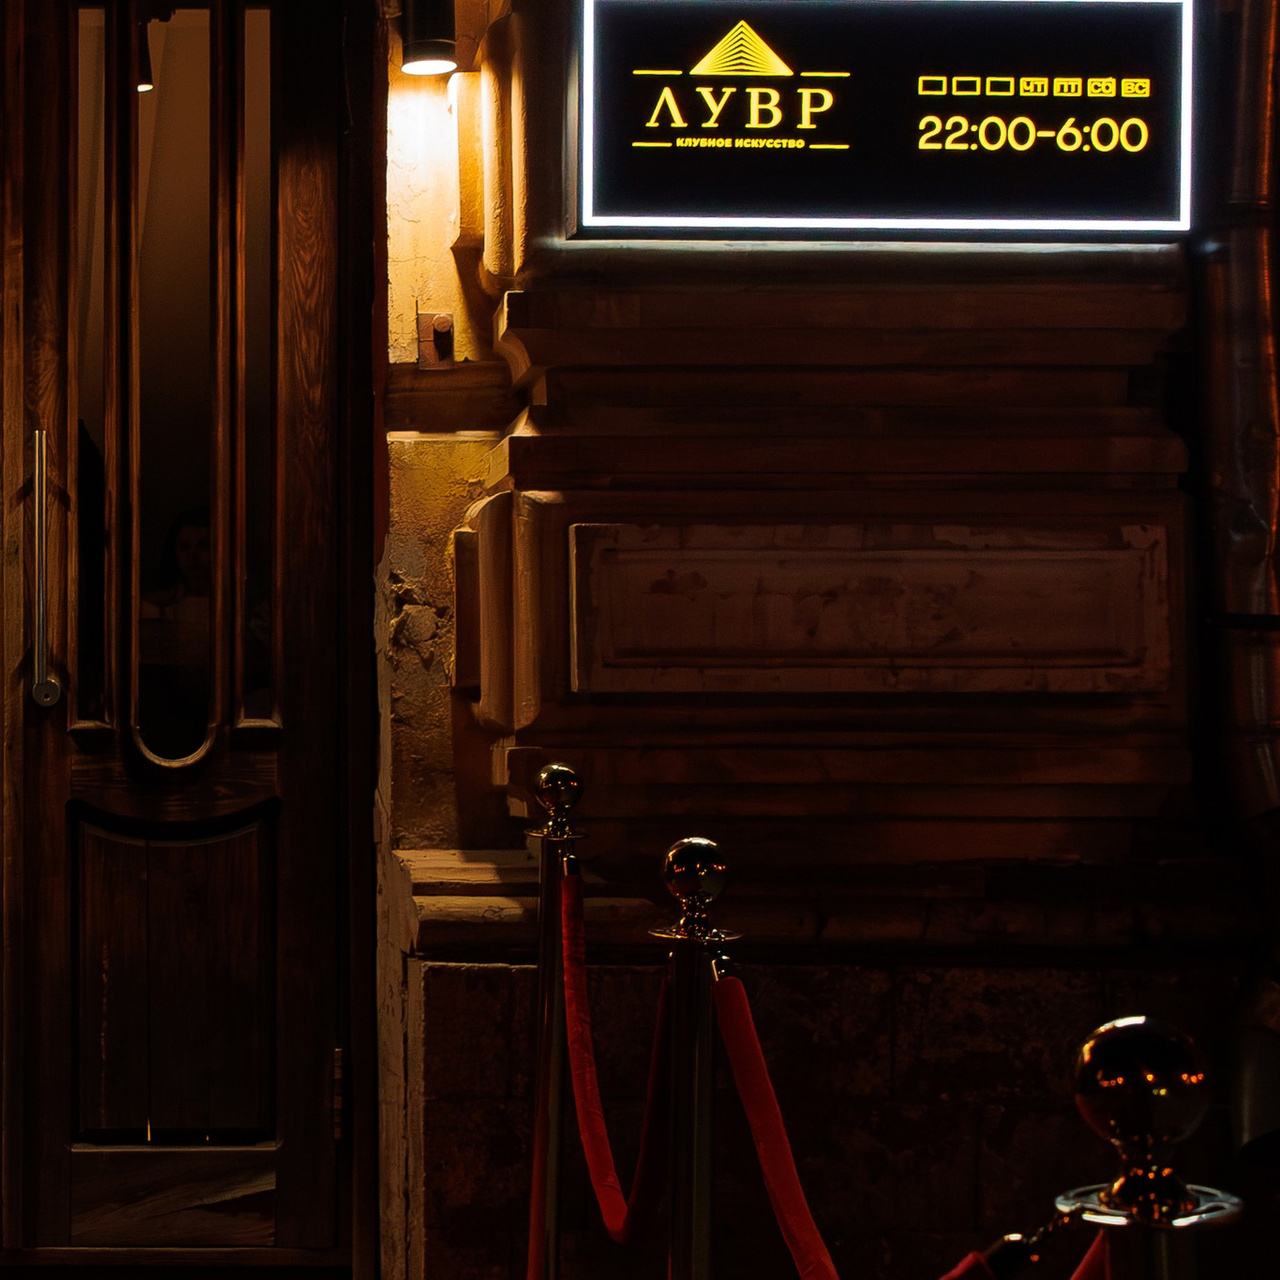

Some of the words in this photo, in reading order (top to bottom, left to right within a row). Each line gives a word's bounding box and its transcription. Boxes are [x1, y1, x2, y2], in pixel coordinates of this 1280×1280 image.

[644, 86, 835, 129] ЛУВР
[675, 137, 733, 148] КЛУБНОЕ
[734, 138, 806, 149] ИСКУССТВО
[918, 115, 1149, 153] 22:00-6:00
